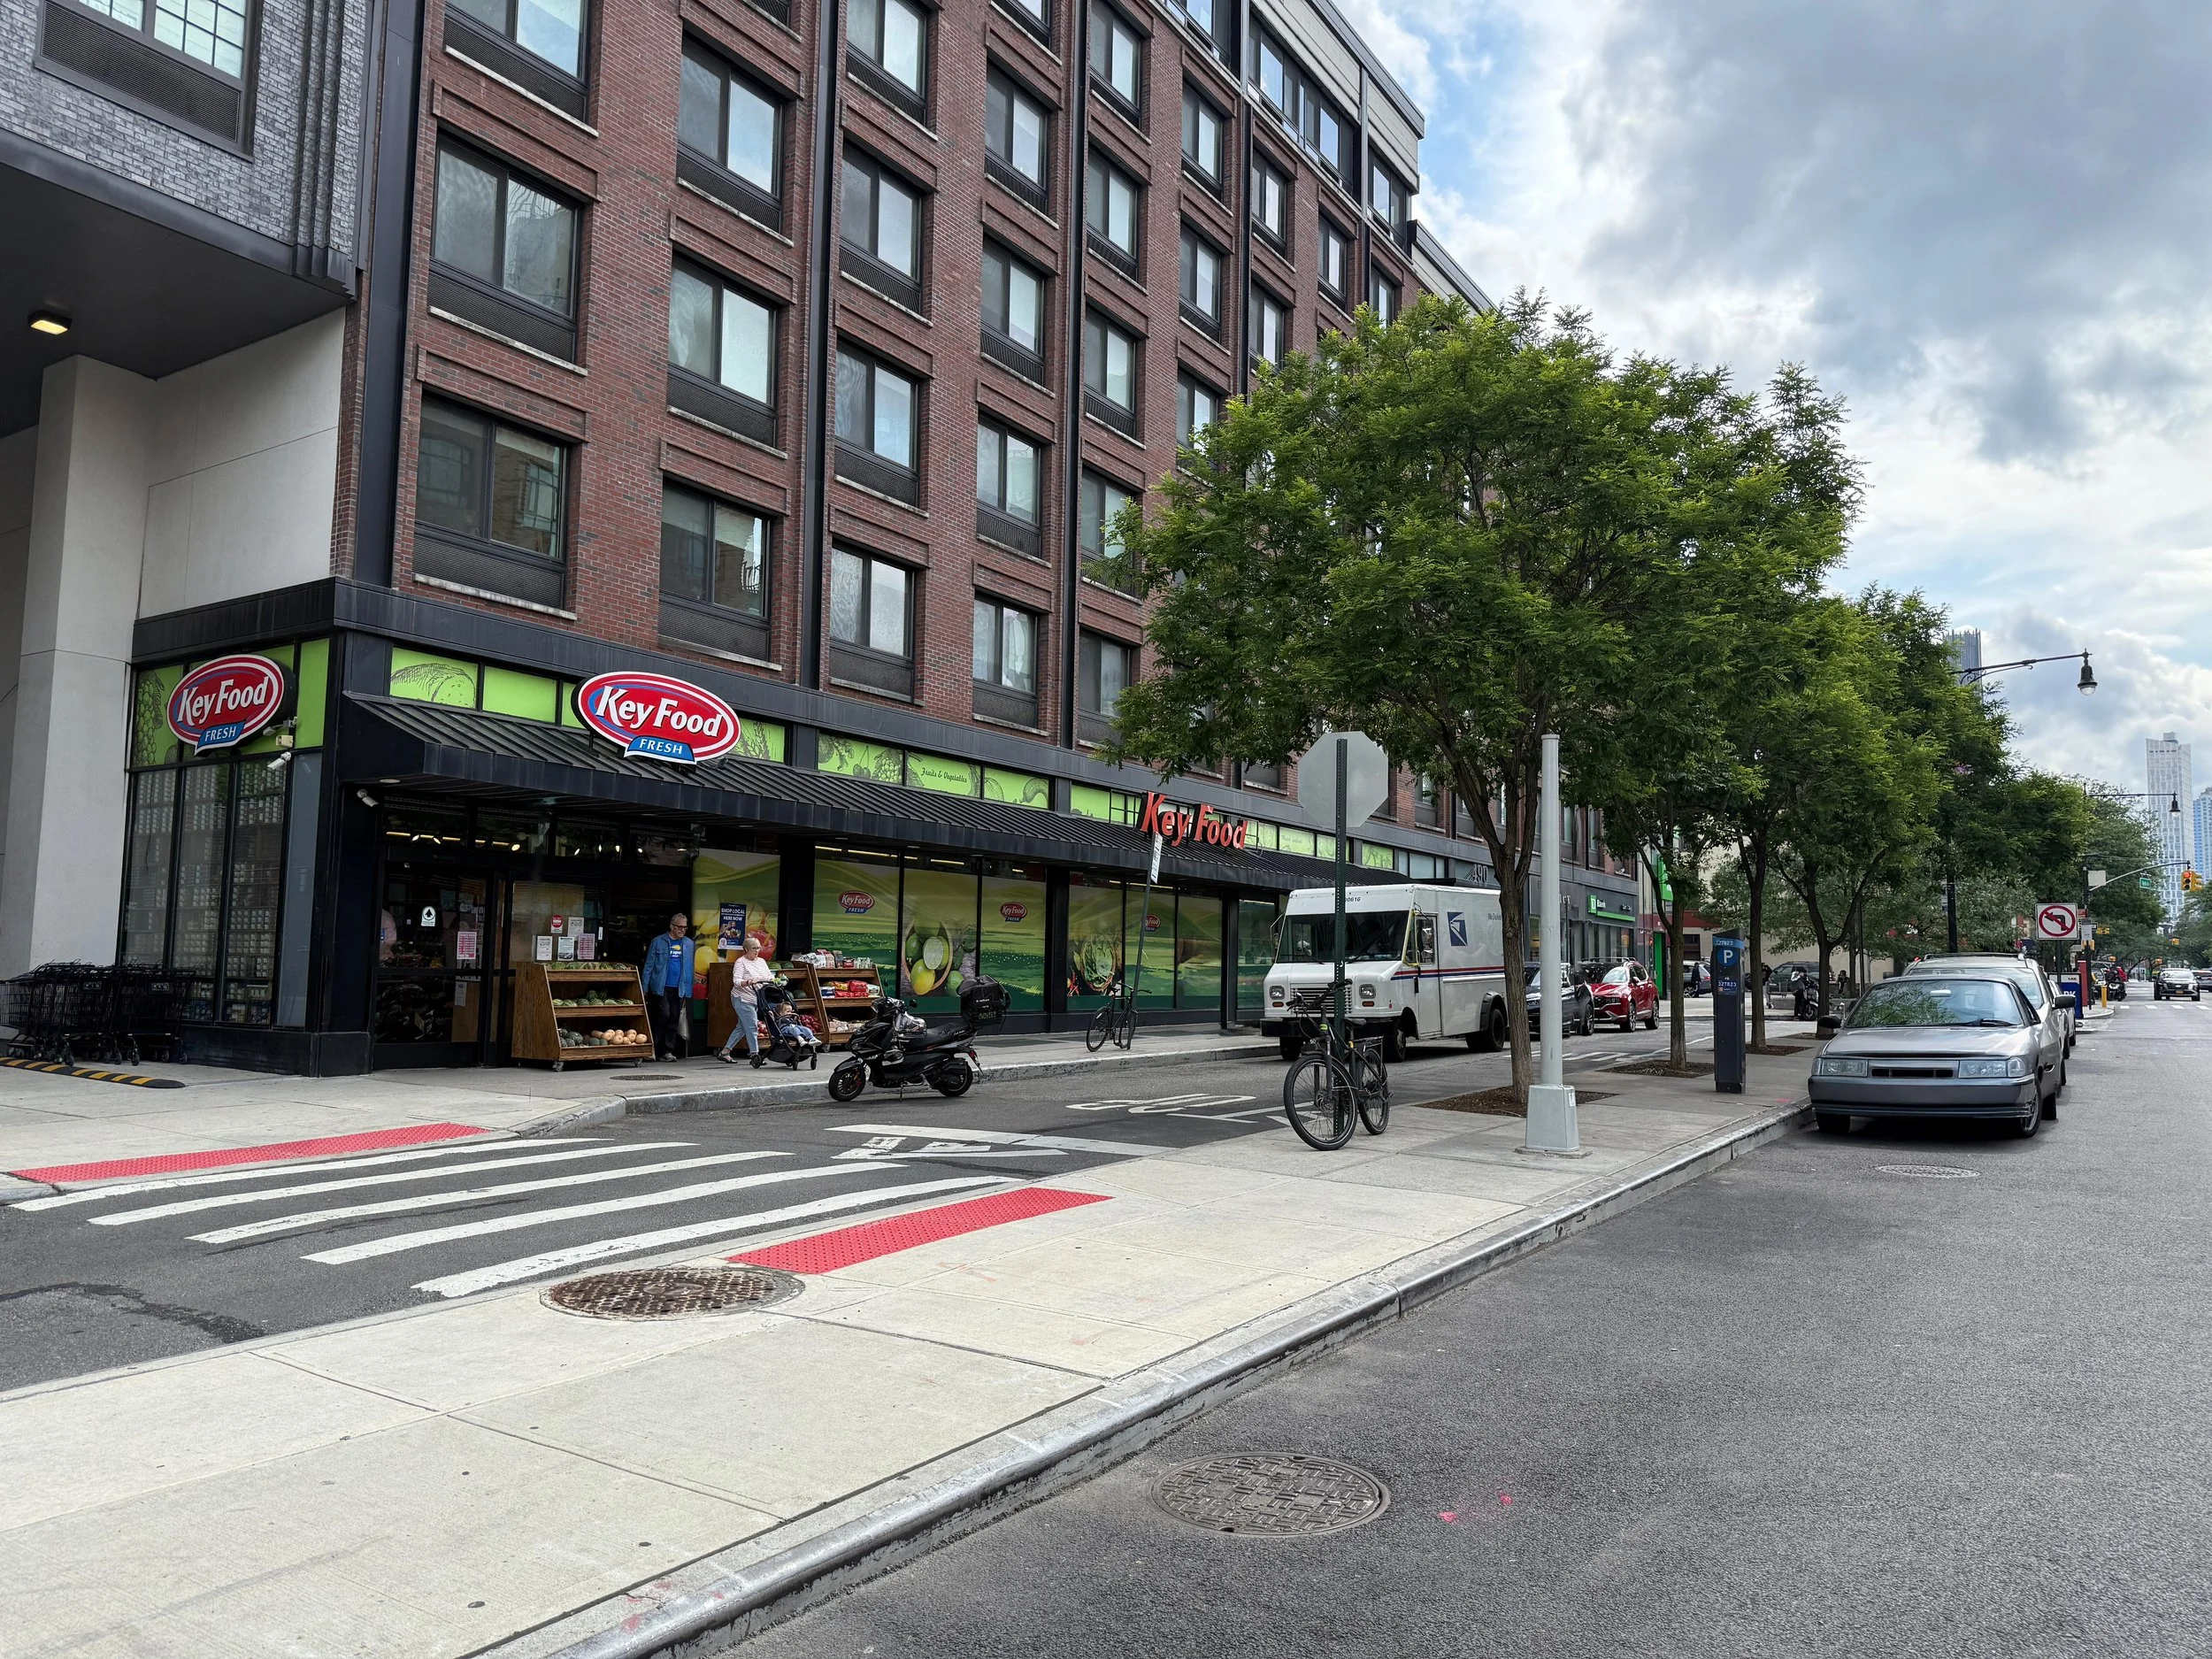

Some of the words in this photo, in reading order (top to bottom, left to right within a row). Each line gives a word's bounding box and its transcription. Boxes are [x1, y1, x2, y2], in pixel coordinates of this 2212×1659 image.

[177, 687, 217, 726] Key
[215, 676, 268, 714] Food
[595, 686, 656, 729] Key
[653, 697, 724, 737] Food
[204, 726, 237, 741] FRESH
[639, 738, 683, 755] FRESH
[921, 767, 936, 777] Fruits
[1140, 791, 1192, 847] Key
[1194, 803, 1248, 849] Food
[841, 894, 855, 905] Key
[855, 895, 871, 904] Food
[1002, 905, 1011, 915] Key
[1724, 949, 1733, 964] P
